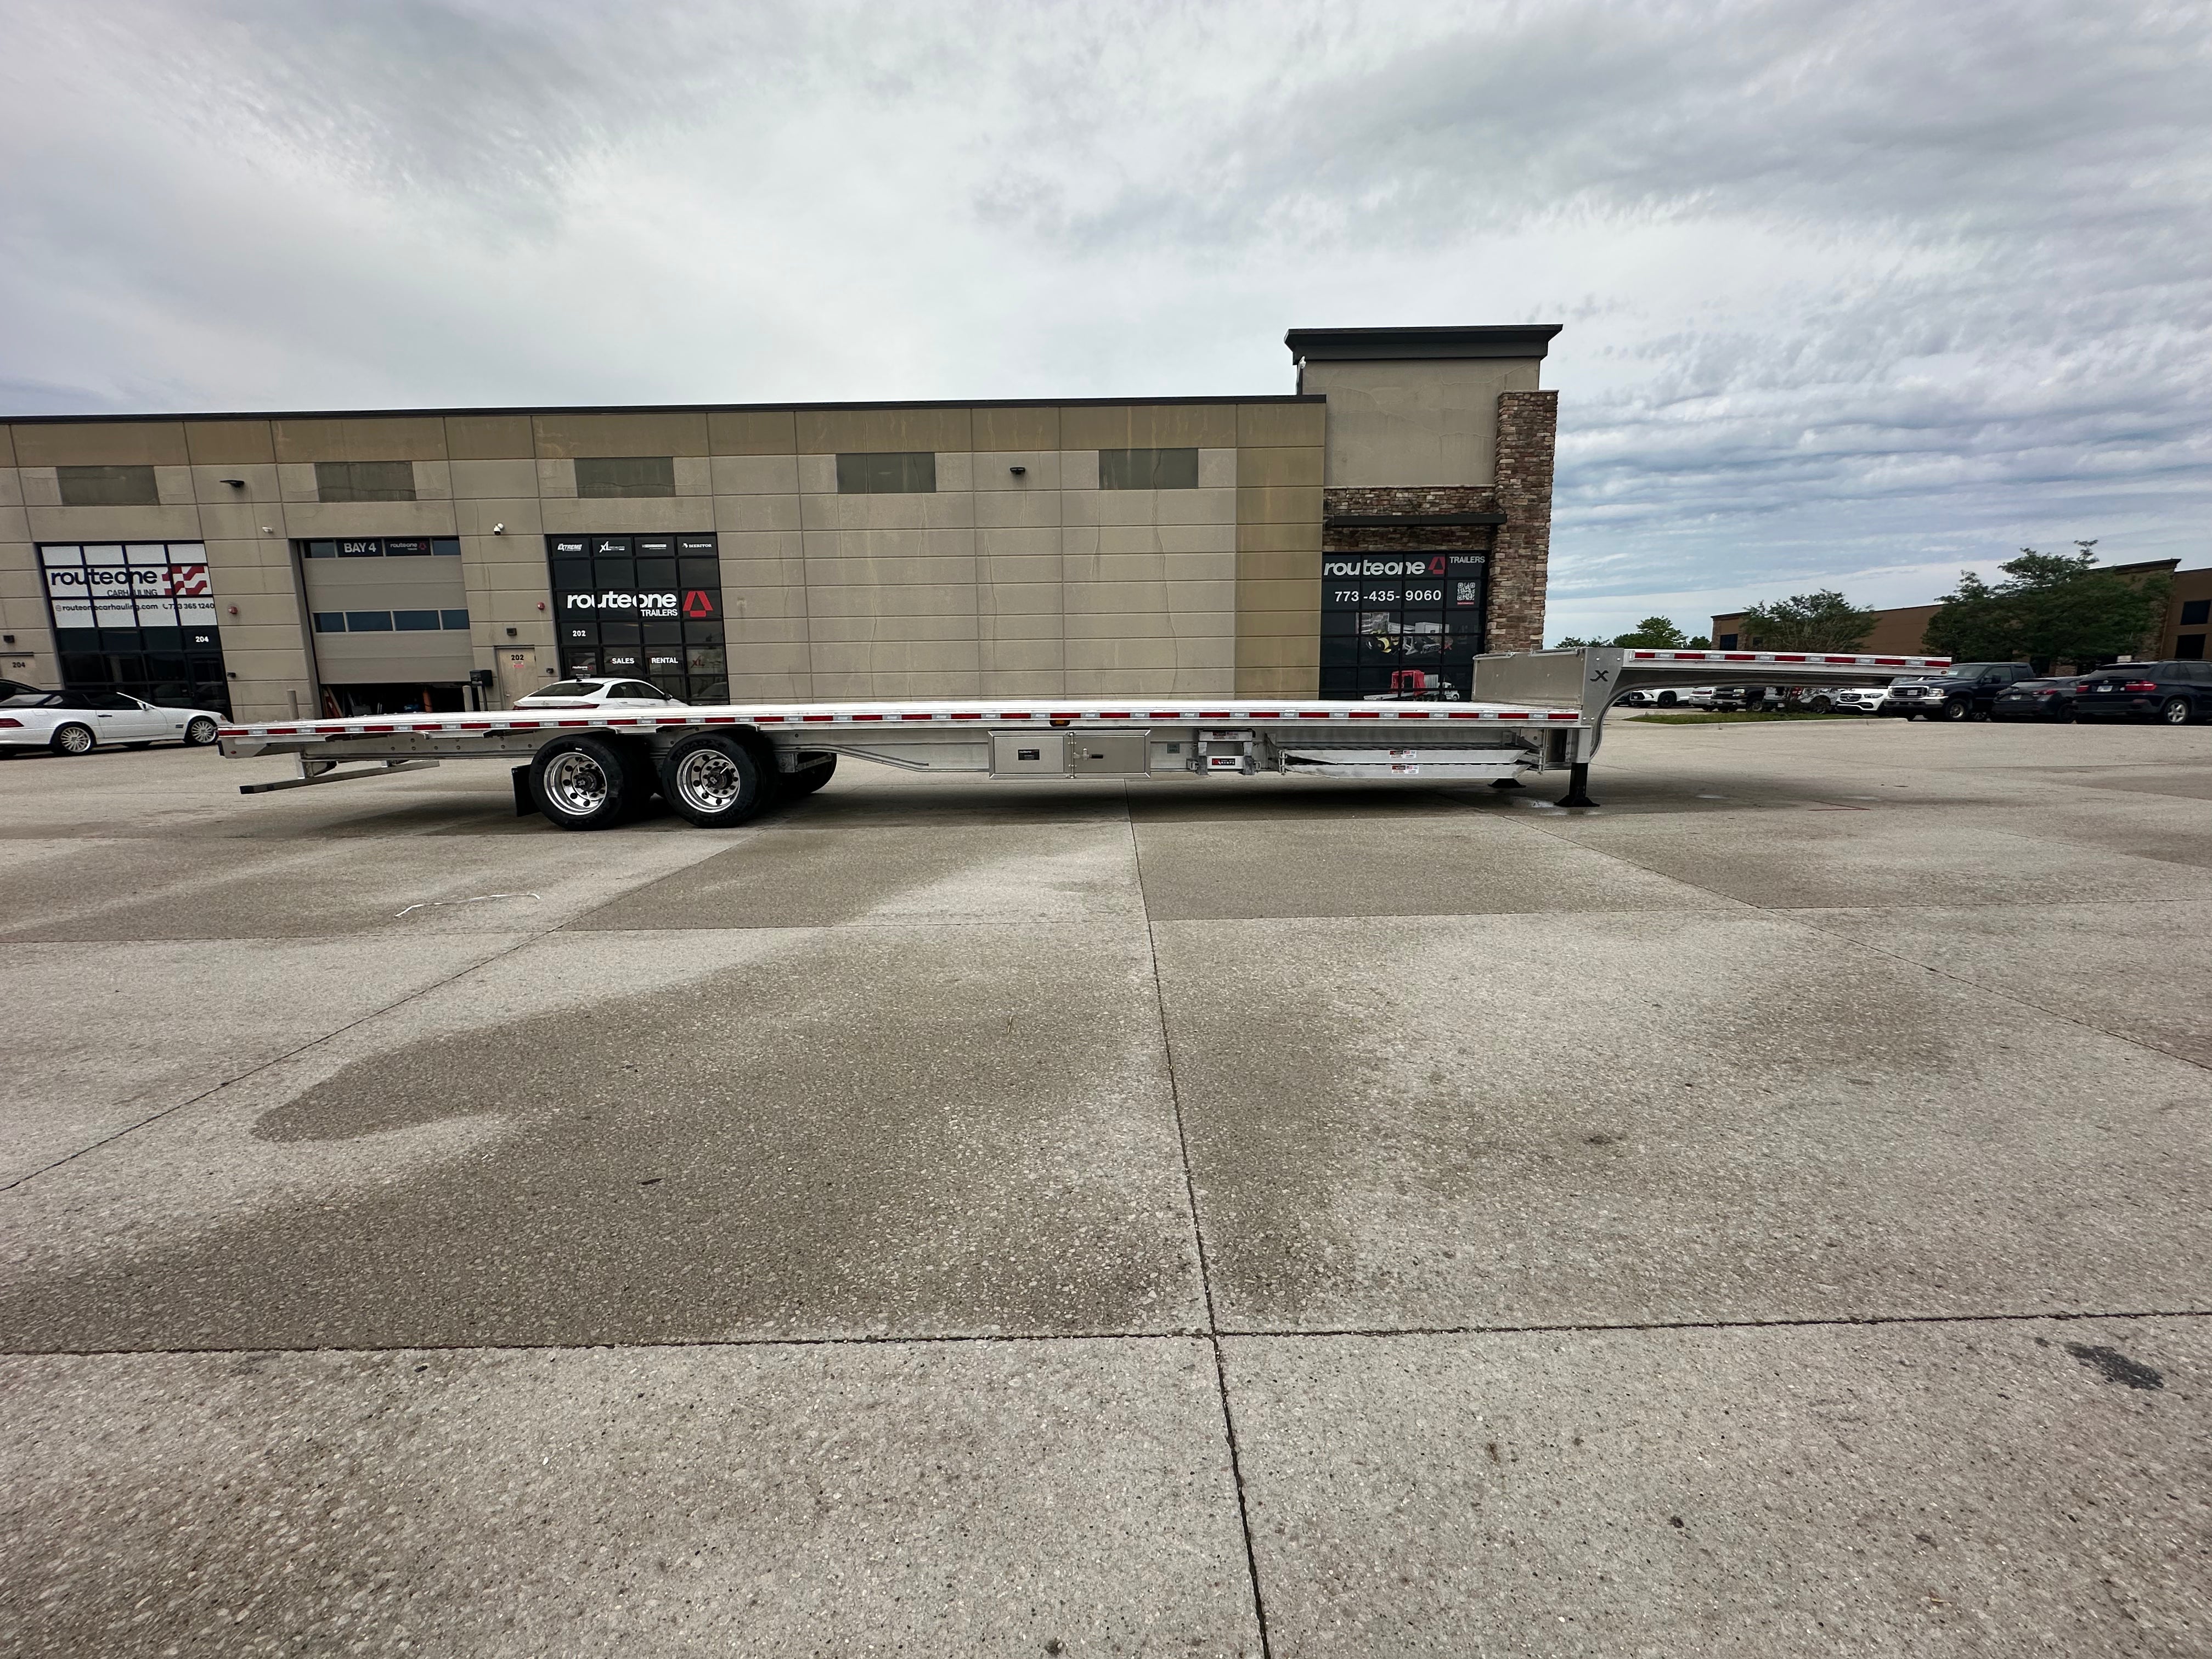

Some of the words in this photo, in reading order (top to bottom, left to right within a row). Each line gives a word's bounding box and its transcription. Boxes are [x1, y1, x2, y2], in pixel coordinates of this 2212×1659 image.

[343, 543, 366, 552] BAY
[369, 543, 376, 552] 4
[1323, 560, 1425, 575] routeone
[51, 568, 157, 585] routeone
[567, 591, 677, 608] routeone
